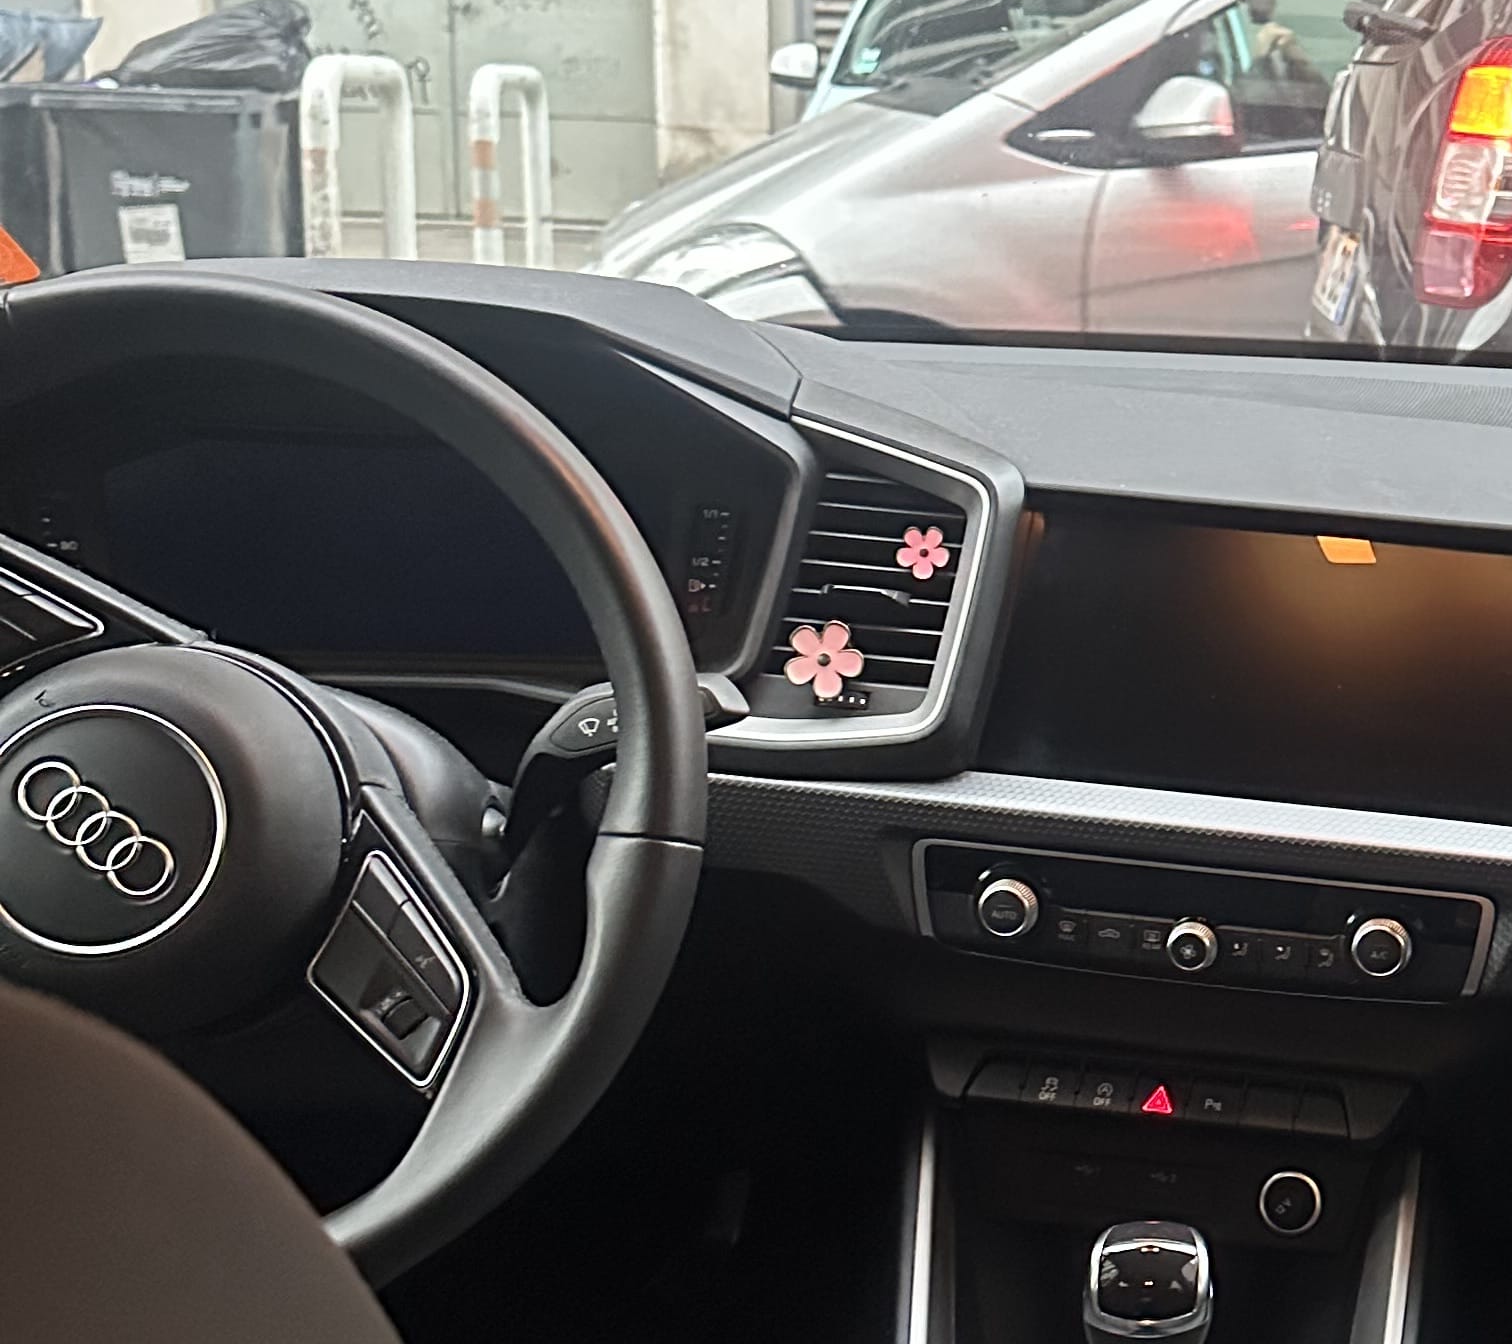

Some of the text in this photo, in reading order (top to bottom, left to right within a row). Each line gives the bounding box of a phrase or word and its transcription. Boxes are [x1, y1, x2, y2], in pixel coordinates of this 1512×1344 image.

[990, 909, 1017, 921] AUTO
[1038, 1090, 1057, 1102] OFF
[1092, 1096, 1111, 1107] OFF
